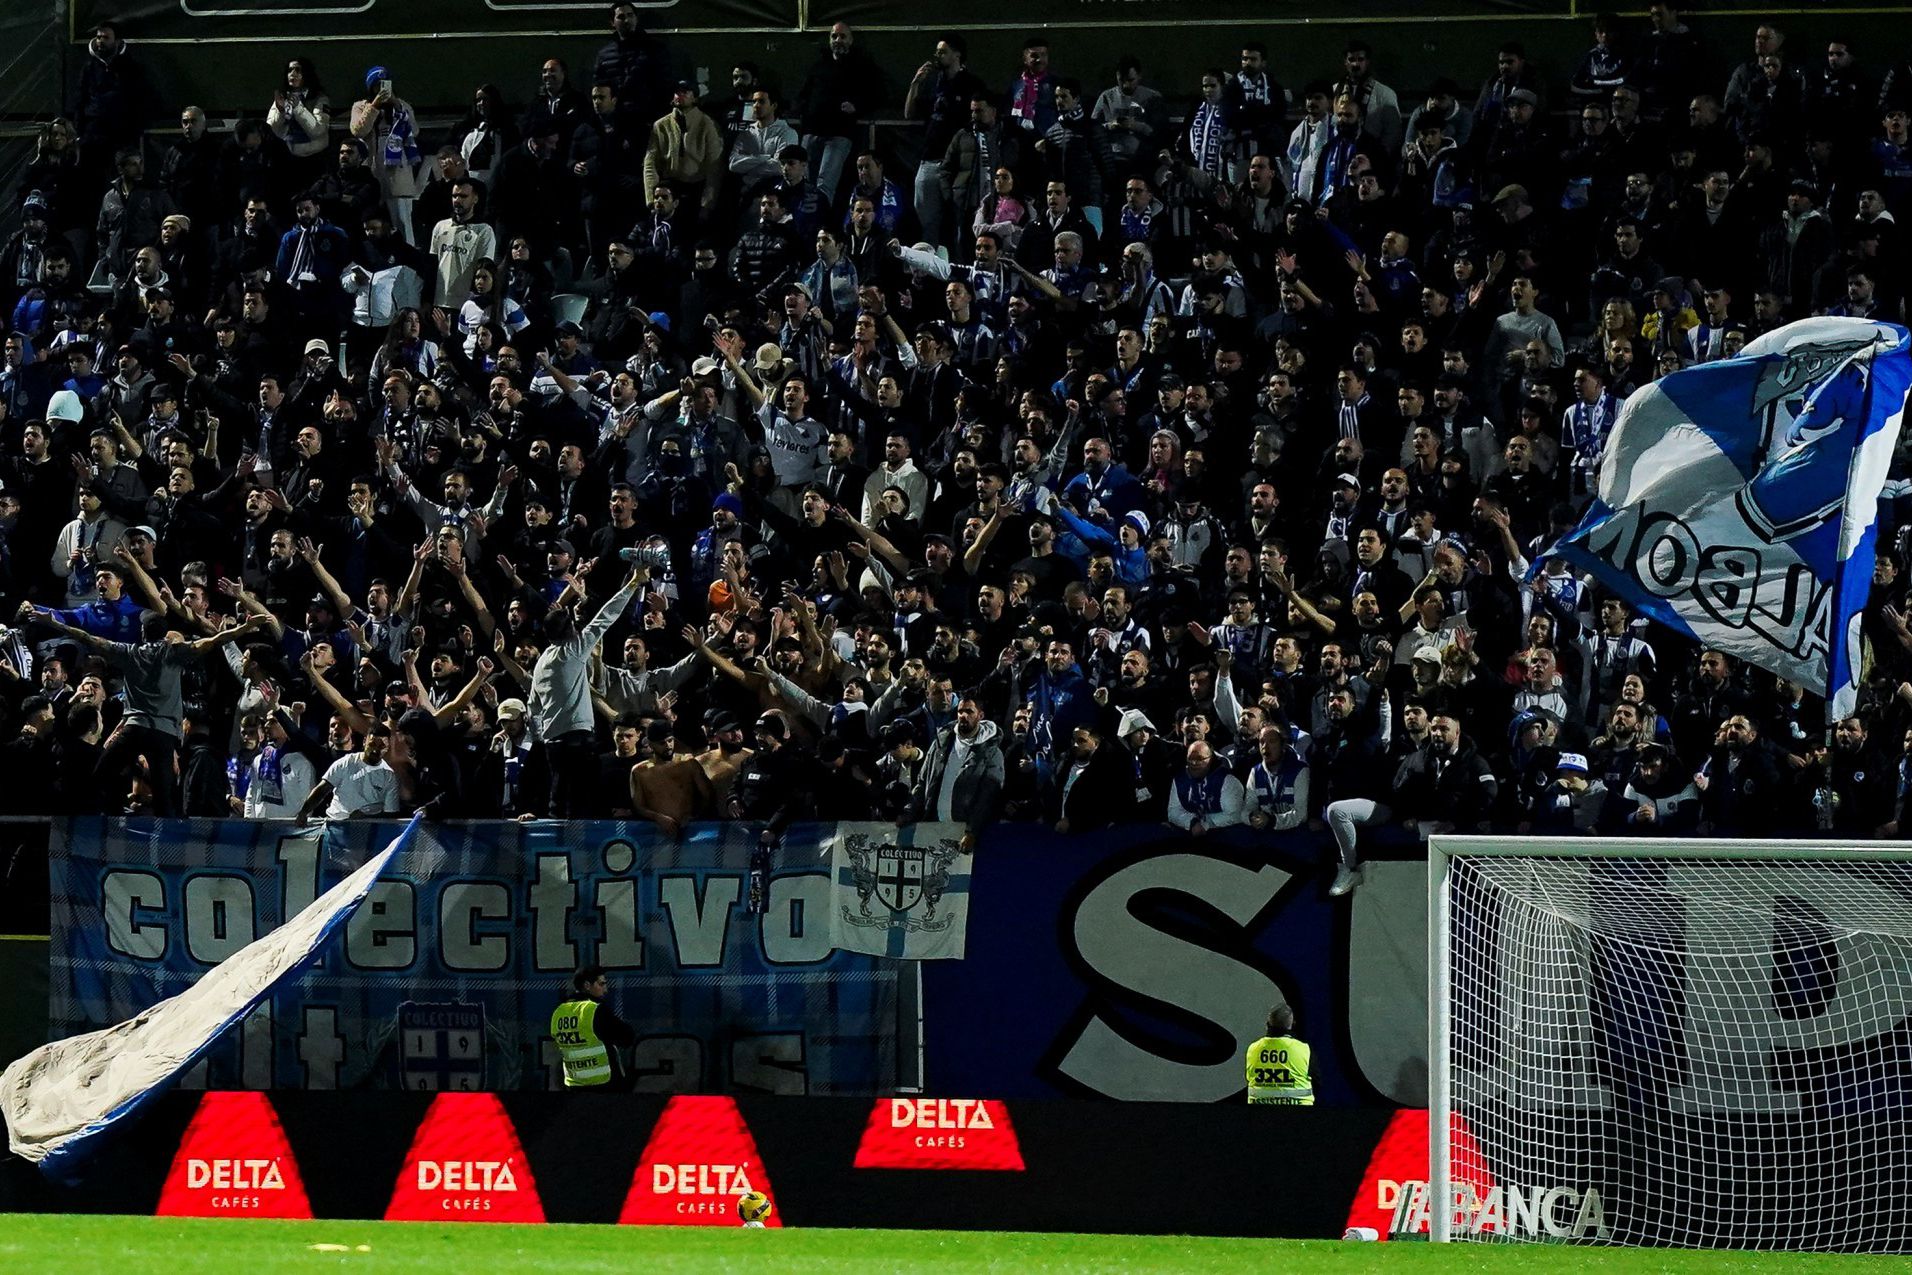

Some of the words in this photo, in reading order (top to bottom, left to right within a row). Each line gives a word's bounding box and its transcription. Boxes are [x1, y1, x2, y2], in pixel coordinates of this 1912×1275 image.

[103, 838, 833, 969] colectivo
[557, 1015, 579, 1031] 080
[1260, 1050, 1288, 1064] 660
[1254, 1068, 1295, 1083] 3XL
[891, 1098, 995, 1130] DELTA
[915, 1134, 965, 1149] CAFÉS
[187, 1158, 286, 1190] DELTA
[417, 1160, 517, 1192] DELTA
[652, 1163, 752, 1195] DELTA
[211, 1194, 259, 1209] CAFÉS
[441, 1196, 491, 1211] CAFÉS
[676, 1200, 726, 1215] CAFÉS
